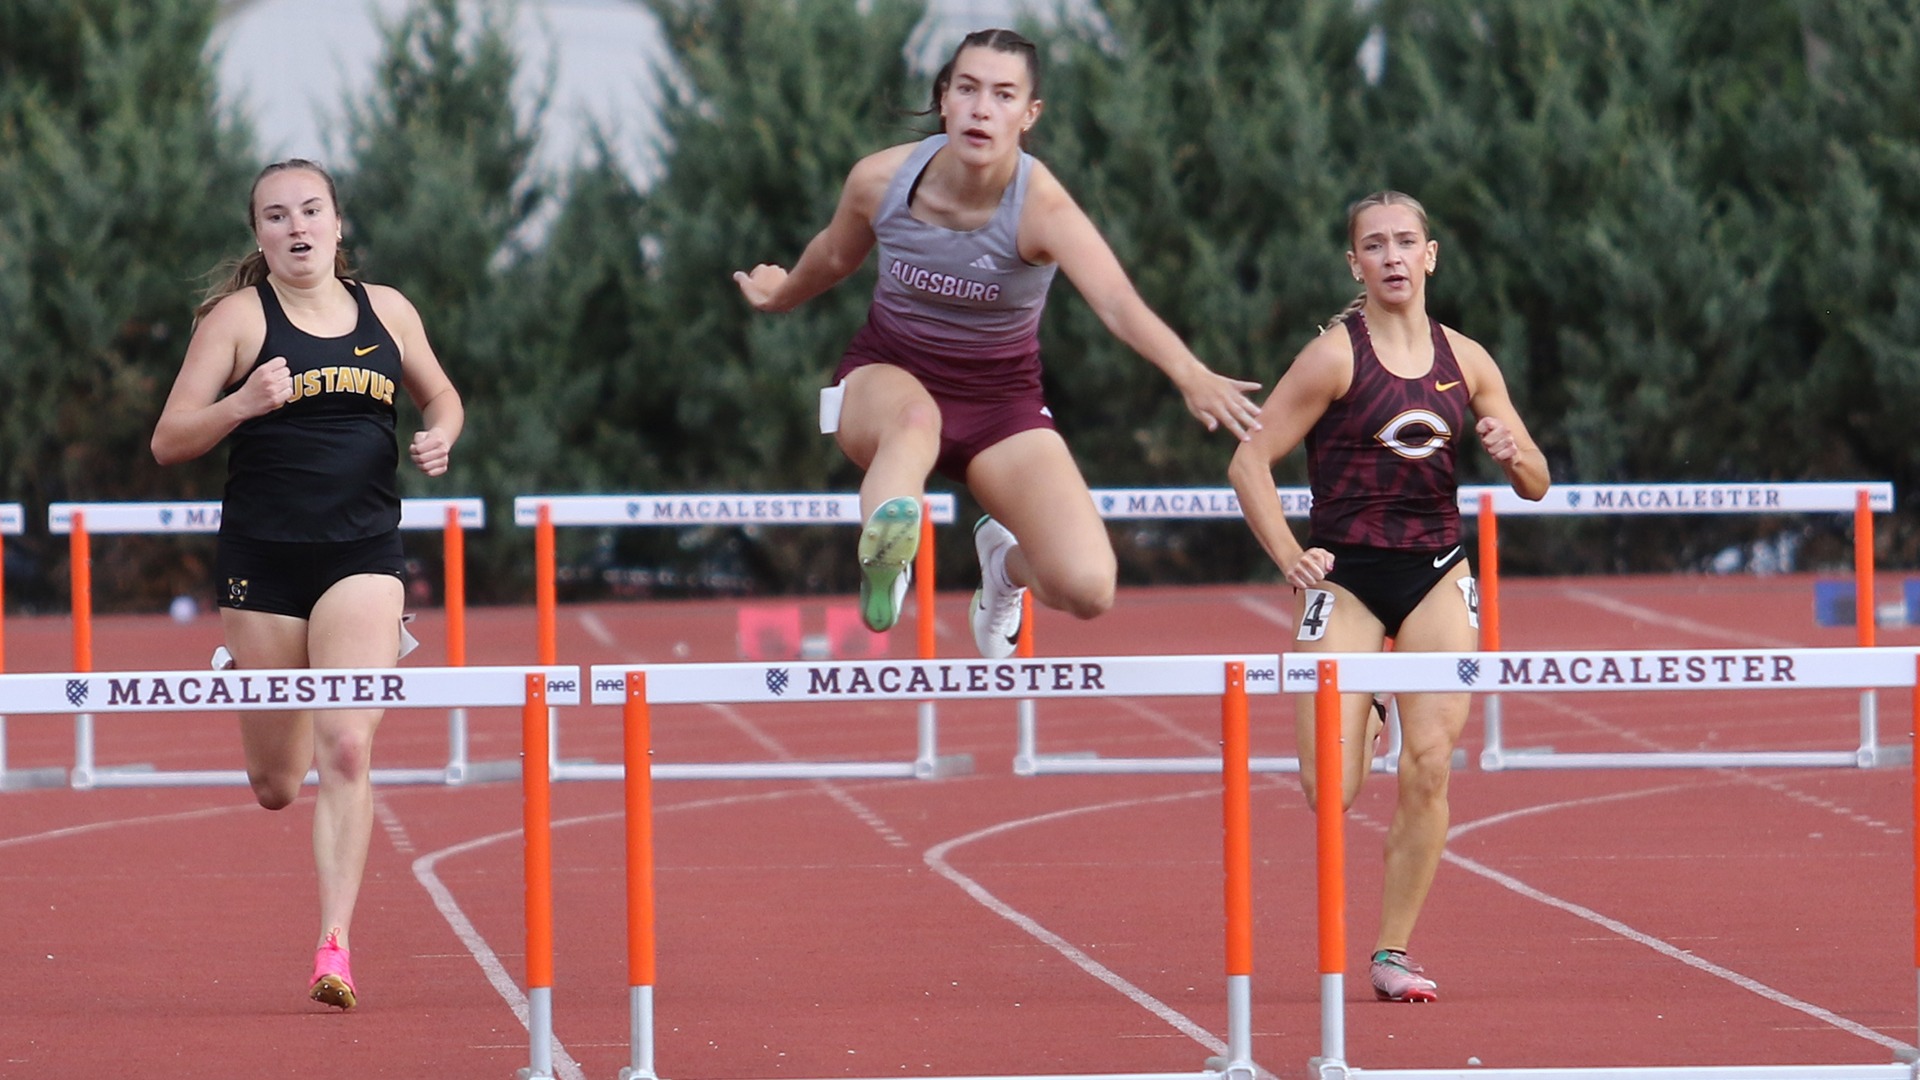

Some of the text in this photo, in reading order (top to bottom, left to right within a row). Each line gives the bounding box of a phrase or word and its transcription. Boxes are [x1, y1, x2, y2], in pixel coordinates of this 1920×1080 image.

[889, 258, 1000, 302] AUGSBURG
[271, 366, 395, 407] USTAVUS
[1373, 408, 1452, 459] C
[652, 500, 841, 519] MACALESTER
[1126, 494, 1312, 513] MACALEER
[1594, 489, 1781, 508] MACALESTER
[1303, 592, 1326, 636] 4
[807, 662, 1106, 694] MACALESTER
[1498, 655, 1796, 685] MACALESTER
[107, 674, 406, 705] MACALESTER
